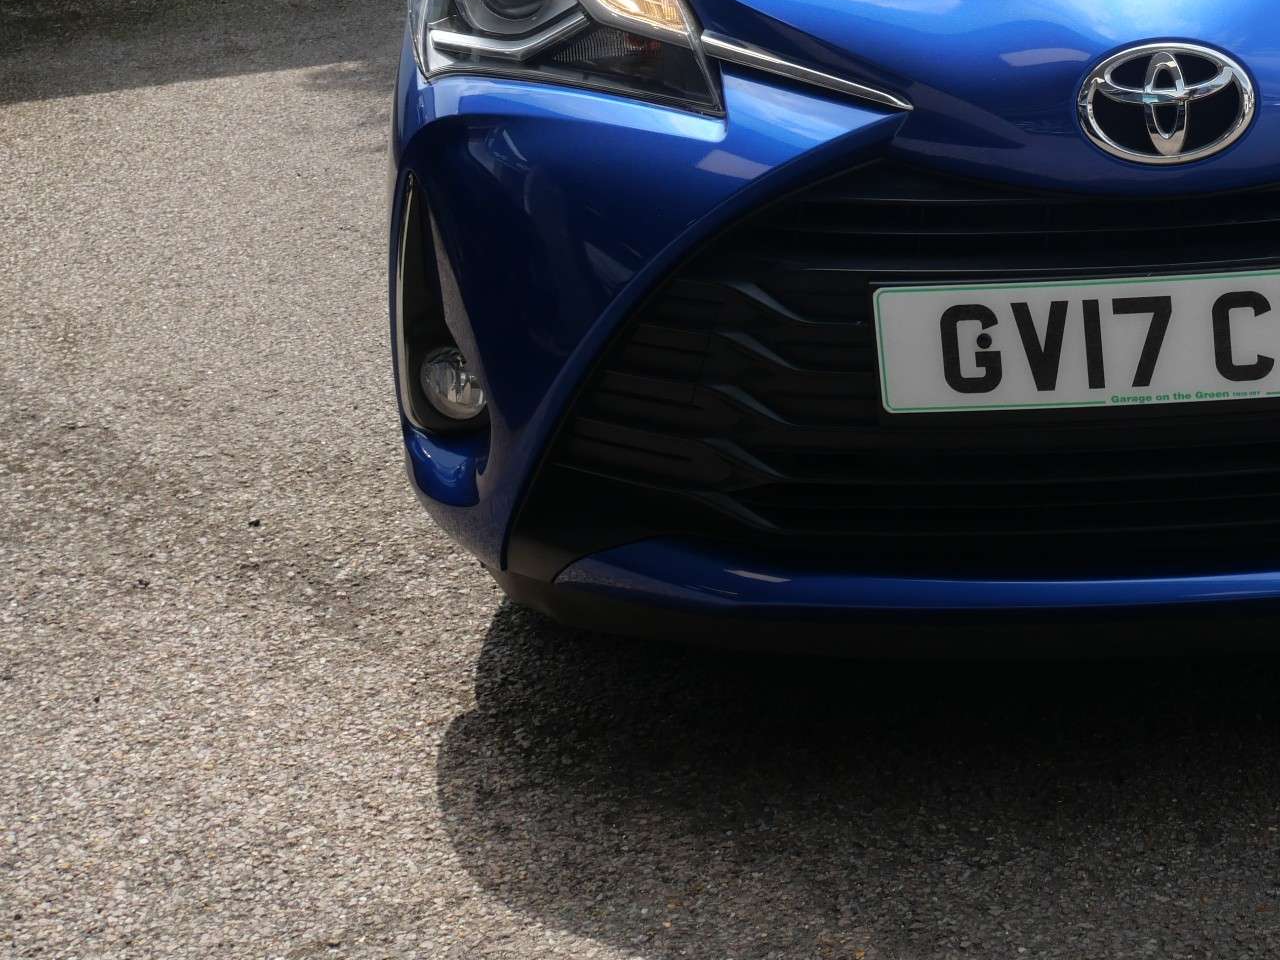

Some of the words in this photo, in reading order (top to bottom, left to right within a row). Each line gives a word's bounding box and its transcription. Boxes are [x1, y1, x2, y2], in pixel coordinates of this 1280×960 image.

[939, 295, 1173, 394] GV17
[1110, 394, 1152, 404] Garage
[1155, 393, 1169, 401] on
[1172, 391, 1192, 400] the
[1195, 390, 1229, 400] Green
